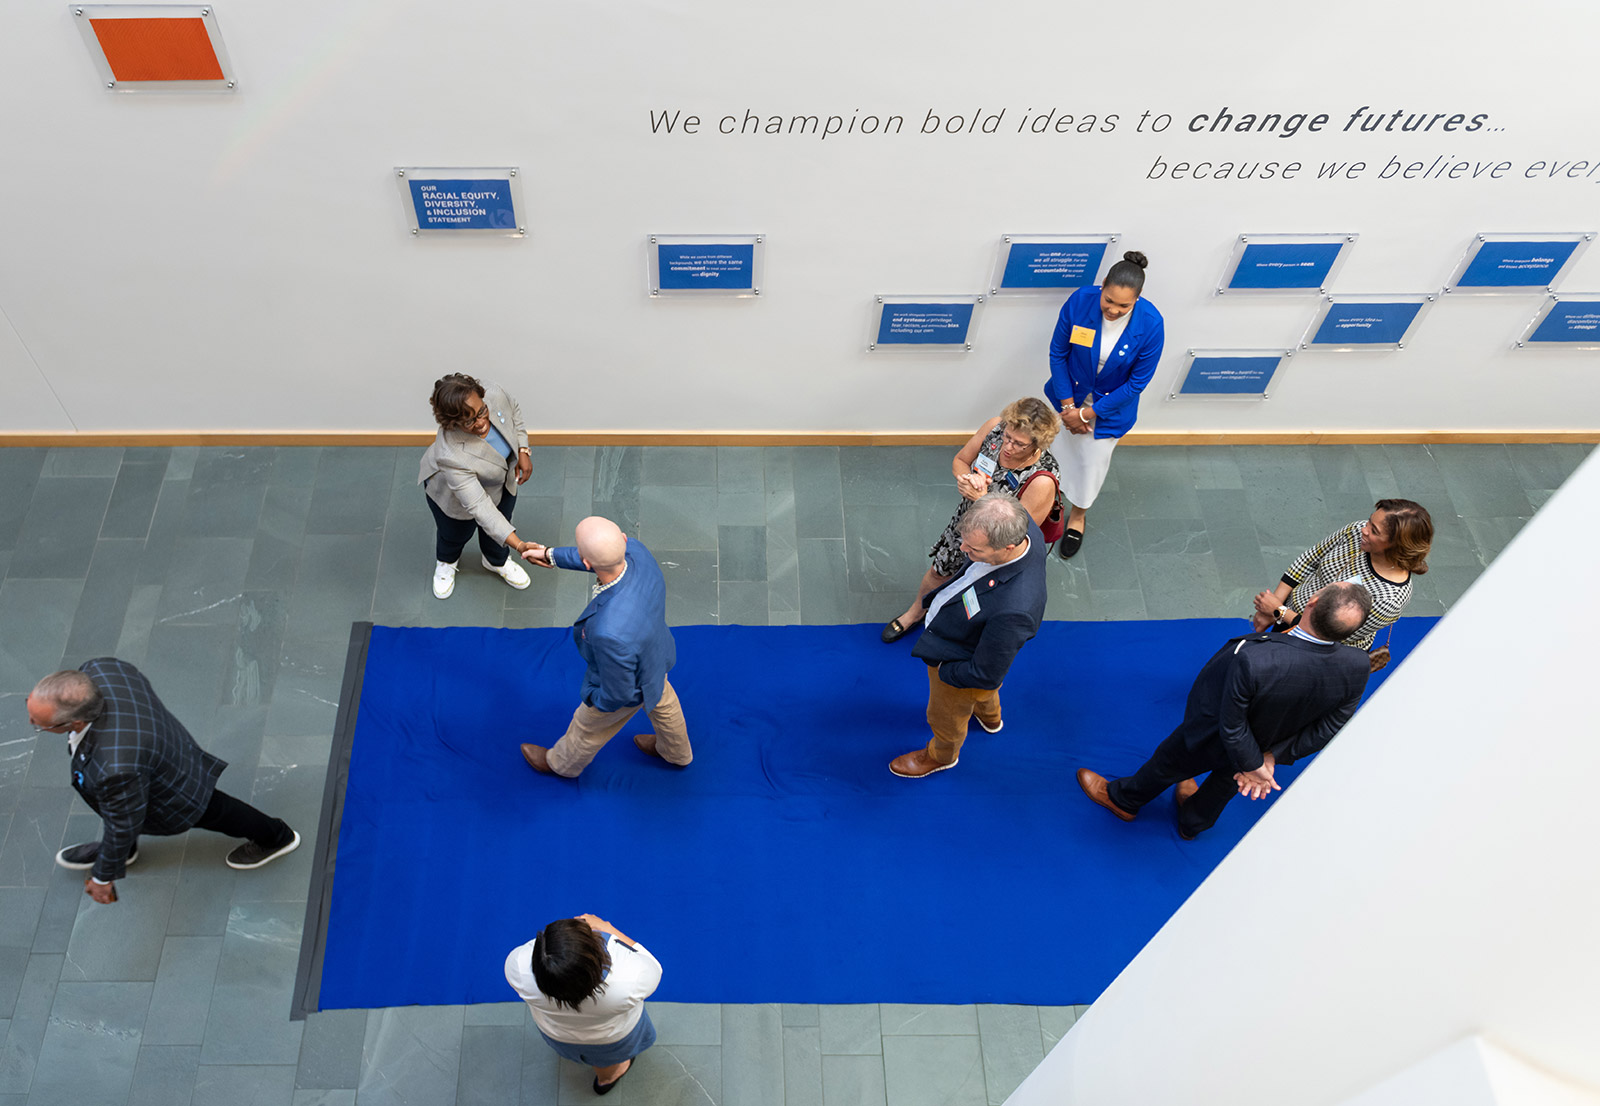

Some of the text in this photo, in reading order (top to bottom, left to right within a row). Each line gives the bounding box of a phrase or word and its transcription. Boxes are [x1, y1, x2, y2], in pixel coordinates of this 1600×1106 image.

[649, 109, 701, 135] We
[718, 108, 904, 141] champion
[919, 107, 1007, 134] bold
[1017, 107, 1120, 134] ideas
[1136, 109, 1173, 133] to
[1187, 106, 1330, 139] change
[1145, 154, 1303, 180] because
[1316, 161, 1367, 180] we
[1377, 154, 1513, 180] believe
[461, 192, 500, 200] EQUITY,
